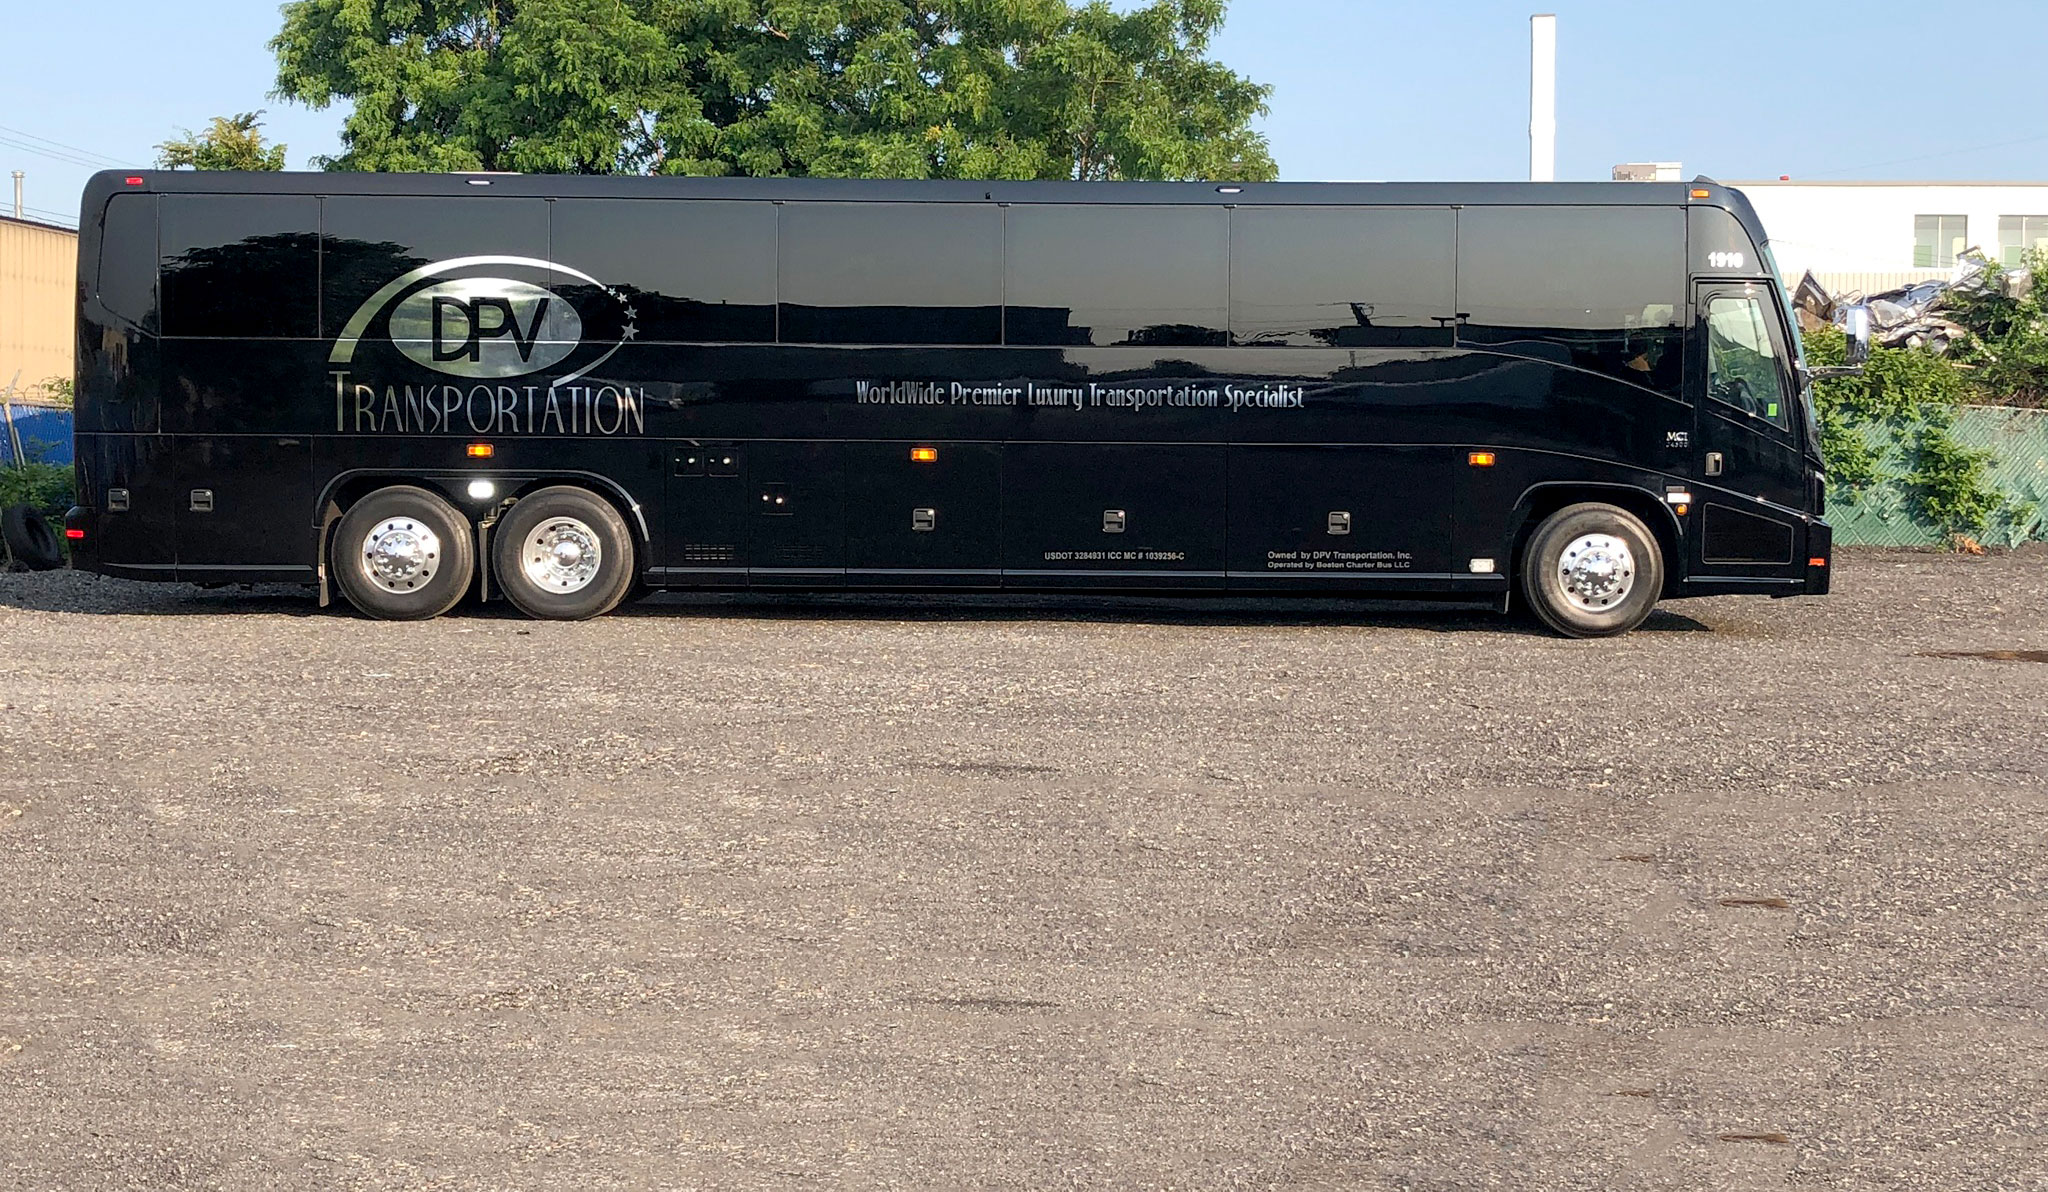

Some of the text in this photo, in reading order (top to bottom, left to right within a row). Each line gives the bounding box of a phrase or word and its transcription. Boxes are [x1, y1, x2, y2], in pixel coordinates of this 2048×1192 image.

[431, 296, 550, 363] DPV
[856, 381, 1304, 412] WorldWide Premier Luxury Transportation Specialist
[1666, 431, 1688, 442] MCI
[1044, 552, 1073, 560] USDOT
[1074, 552, 1105, 560] 3284931
[1107, 552, 1122, 560] ICC
[1124, 552, 1136, 560] MC
[1267, 551, 1297, 559] Owned
[1301, 551, 1311, 560] by
[1313, 551, 1331, 559] DPV
[1397, 551, 1413, 560] Inc.
[1267, 561, 1303, 569] Operated
